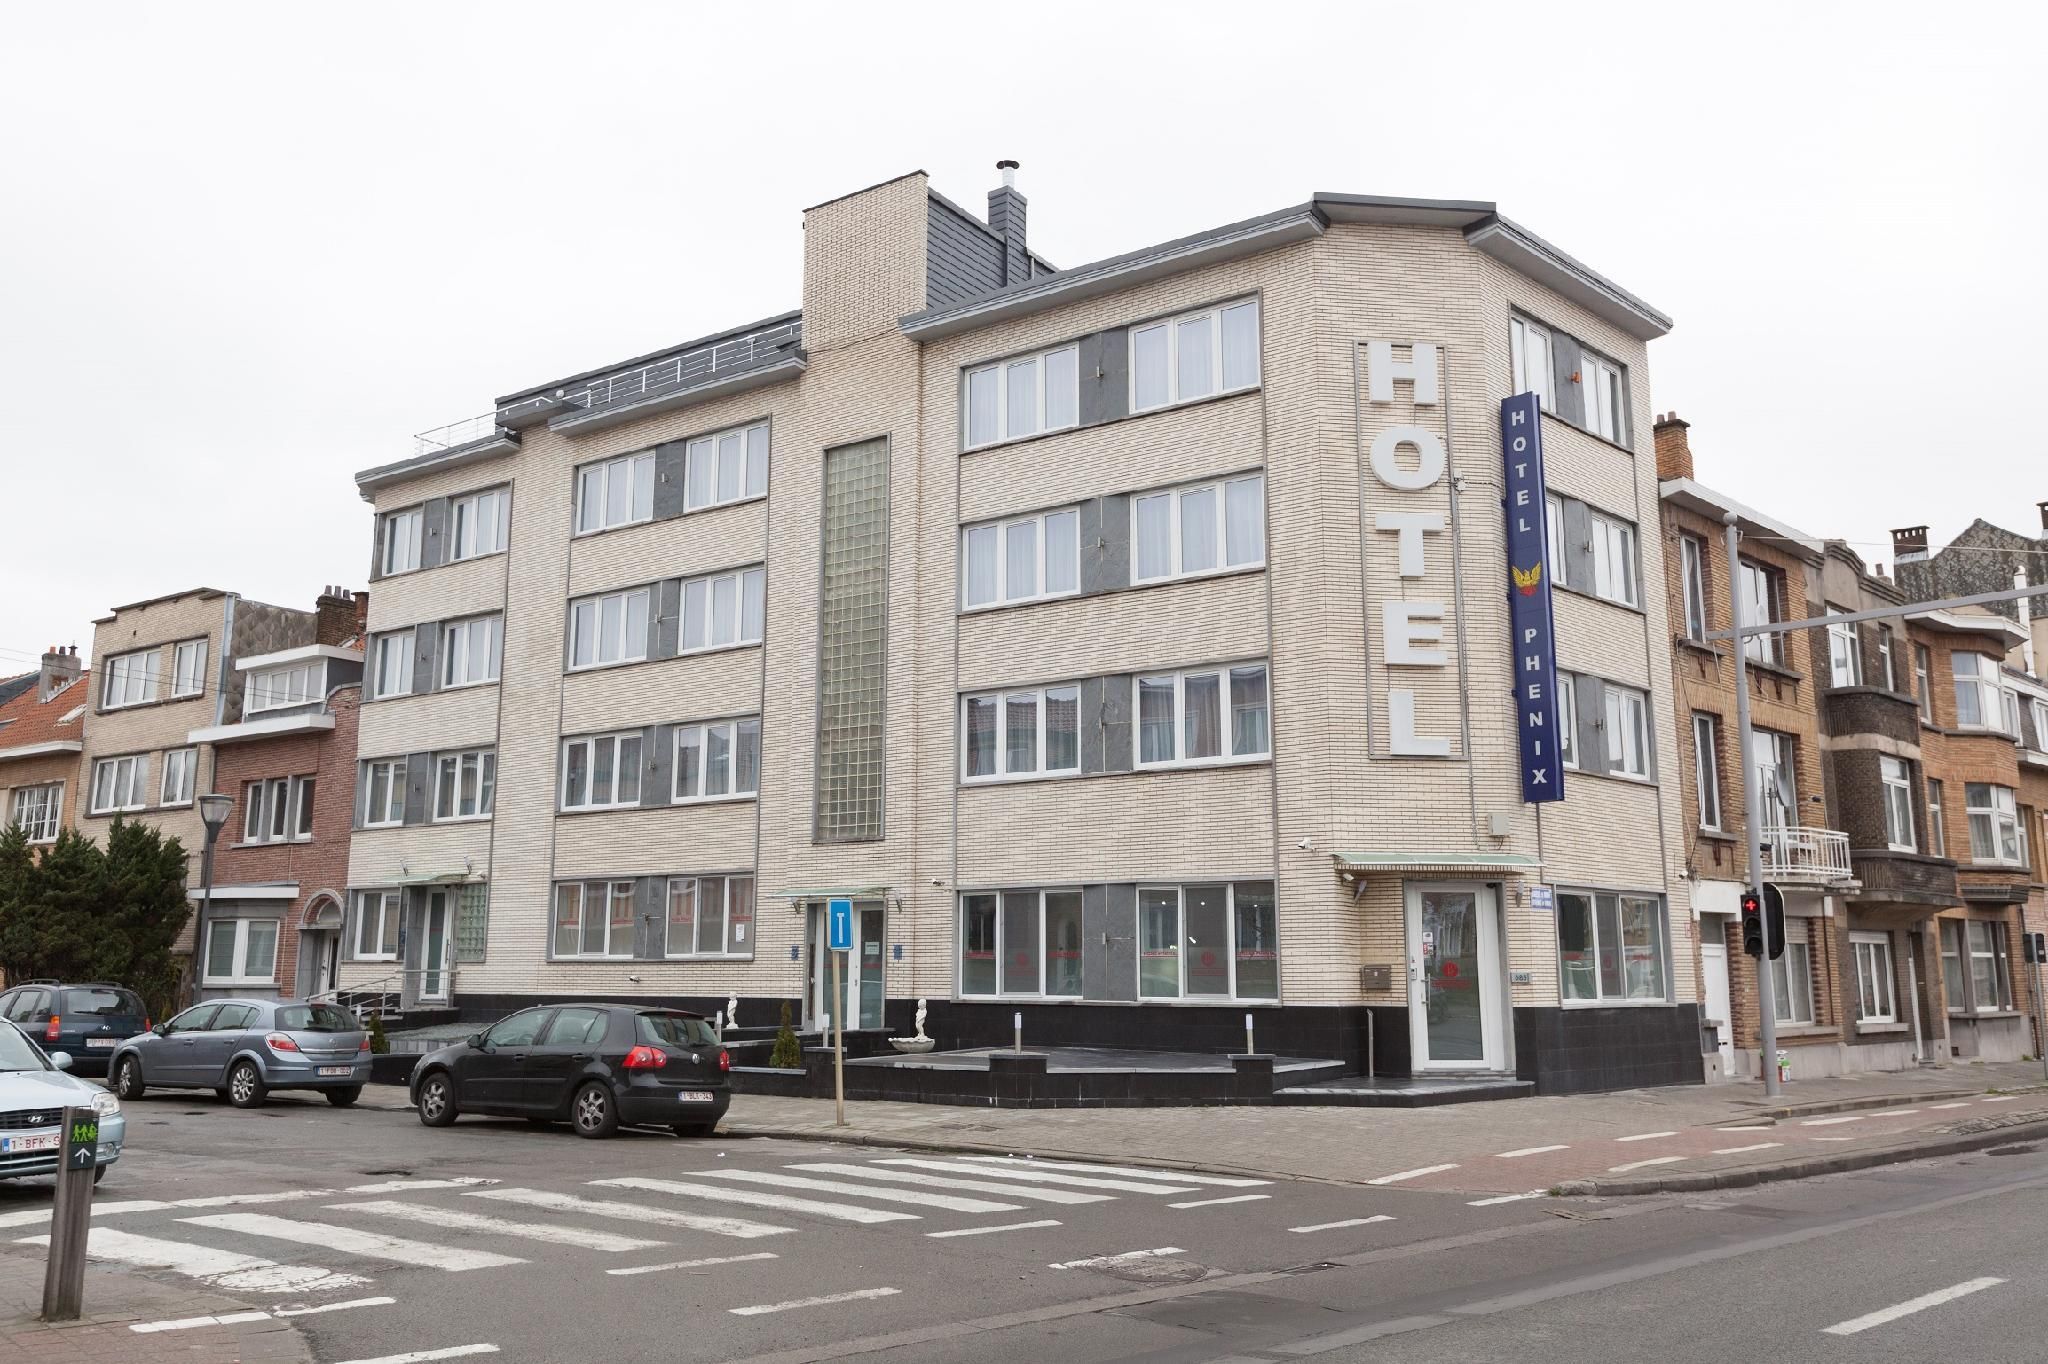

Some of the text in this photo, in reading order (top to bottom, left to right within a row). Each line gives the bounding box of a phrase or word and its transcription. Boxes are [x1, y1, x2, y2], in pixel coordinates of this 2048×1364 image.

[1368, 342, 1450, 756] HOTEL
[1511, 410, 1548, 785] HOTEL PHENIX
